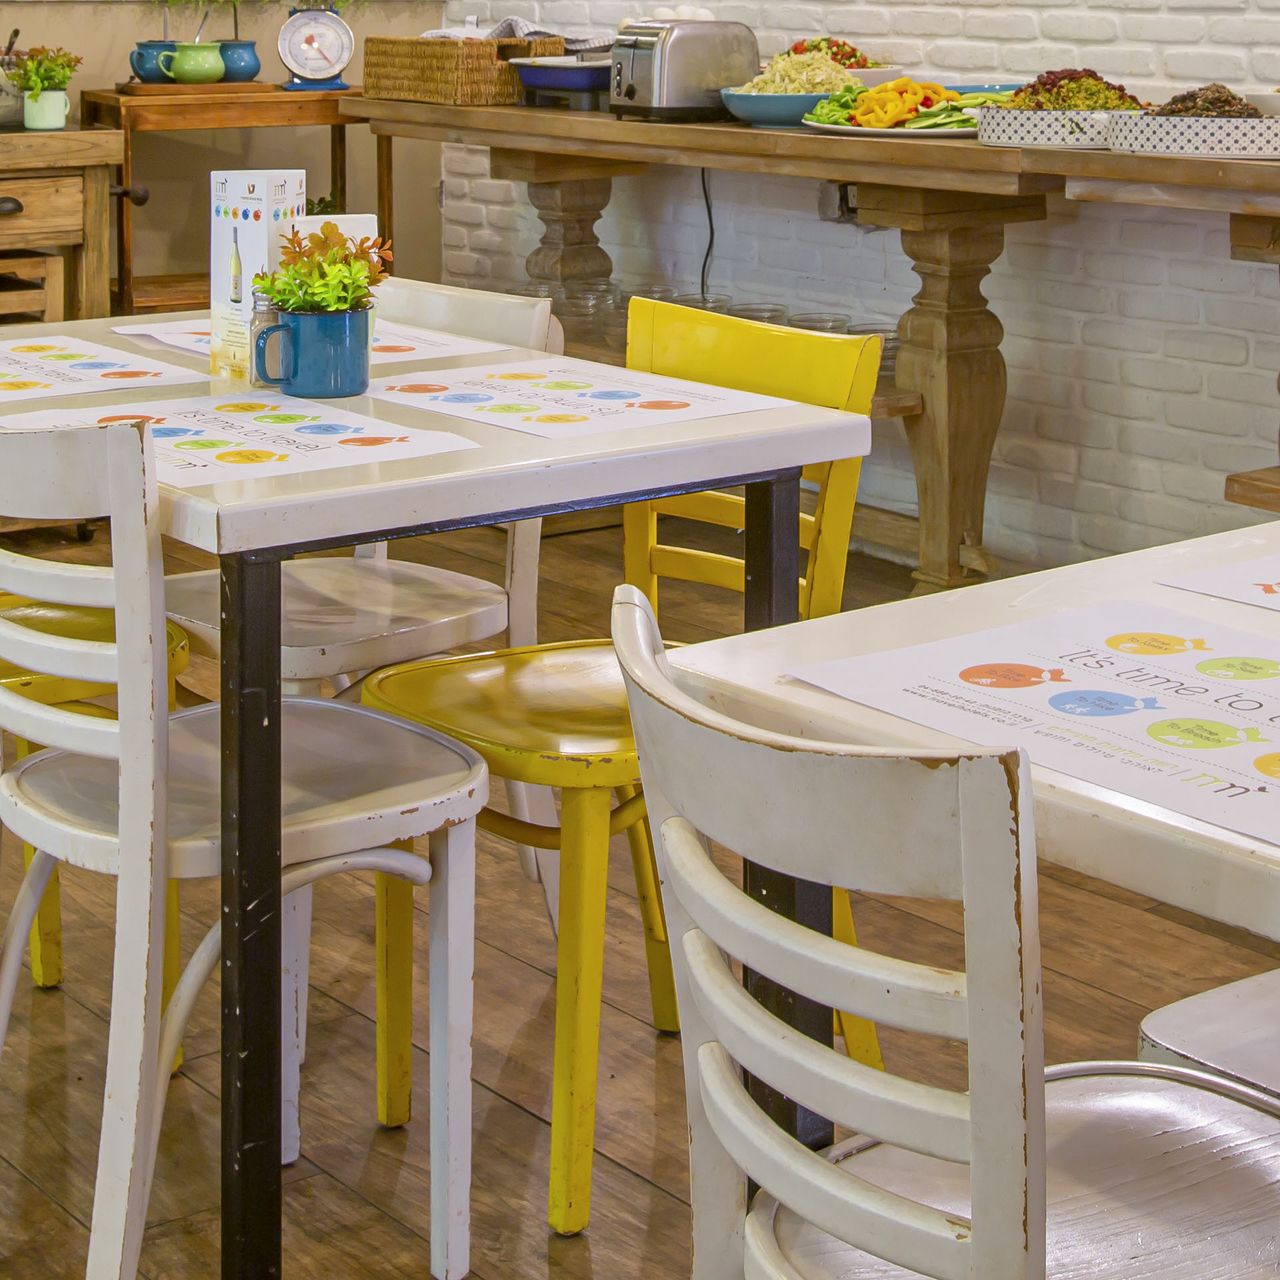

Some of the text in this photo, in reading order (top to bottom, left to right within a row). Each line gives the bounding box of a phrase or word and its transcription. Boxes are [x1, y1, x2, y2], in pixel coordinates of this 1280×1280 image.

[1058, 648, 1115, 670] It's
[1115, 667, 1210, 696] time
[1214, 692, 1264, 712] to
